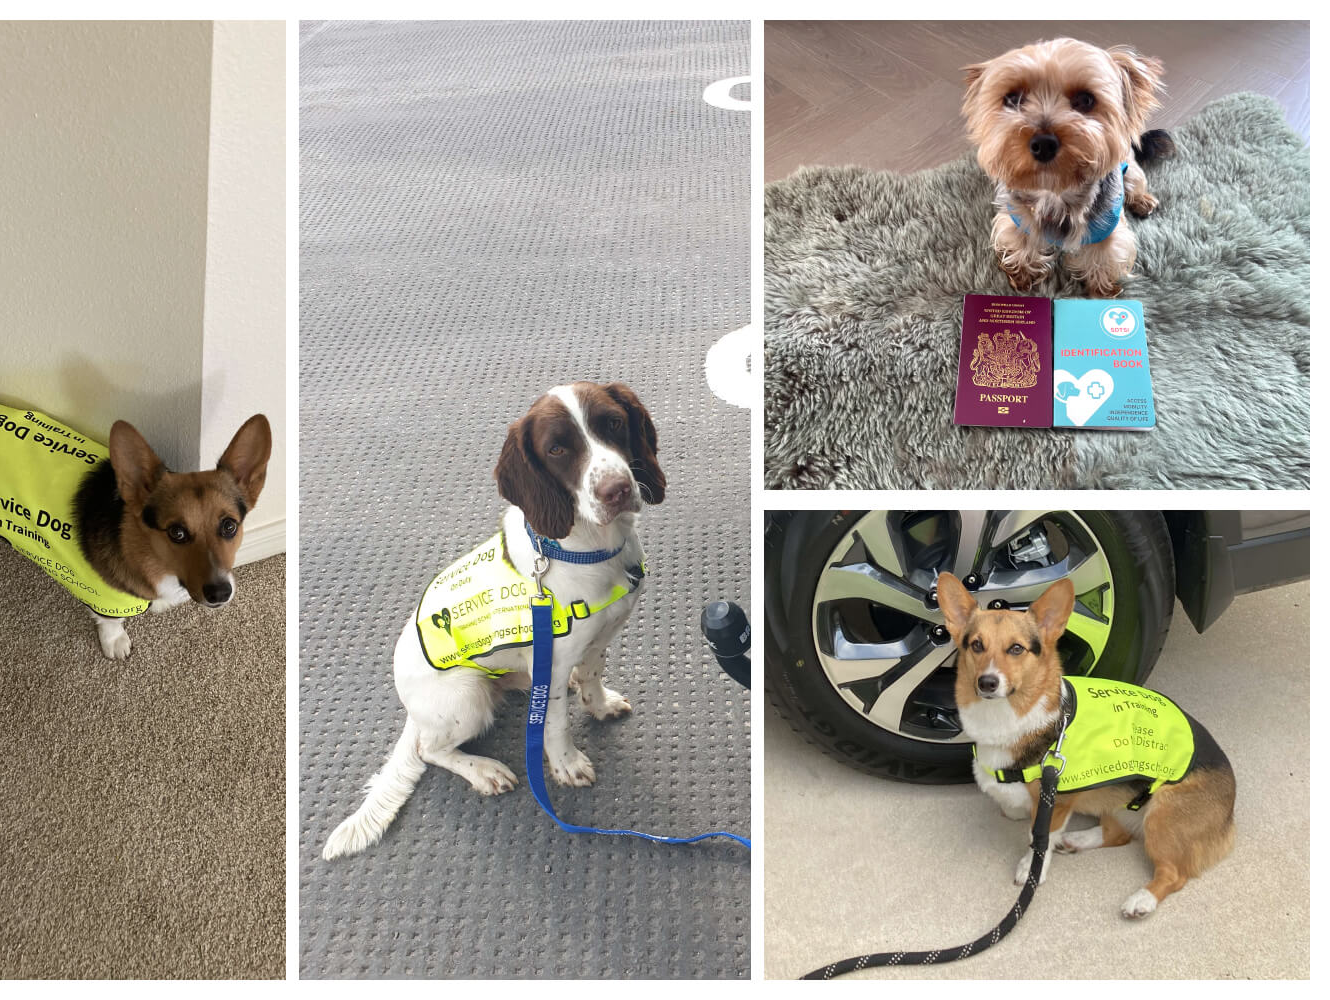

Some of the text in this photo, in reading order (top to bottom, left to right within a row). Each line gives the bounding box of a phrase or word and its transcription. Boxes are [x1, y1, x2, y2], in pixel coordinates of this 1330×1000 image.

[1060, 348, 1142, 358] IDENTIFICATION
[1113, 359, 1143, 369] BOOK
[979, 393, 1028, 404] PASSPORT
[24, 411, 72, 439] Training
[33, 431, 98, 465] Service
[5, 520, 51, 549] Training
[36, 510, 72, 540] Dog
[451, 582, 527, 620] SERVICE DOG
[529, 684, 548, 724] SERVICE DOG
[1087, 687, 1138, 699] Service
[1113, 703, 1124, 713] In
[1113, 738, 1129, 748] Do
[1136, 735, 1169, 751] Distrac
